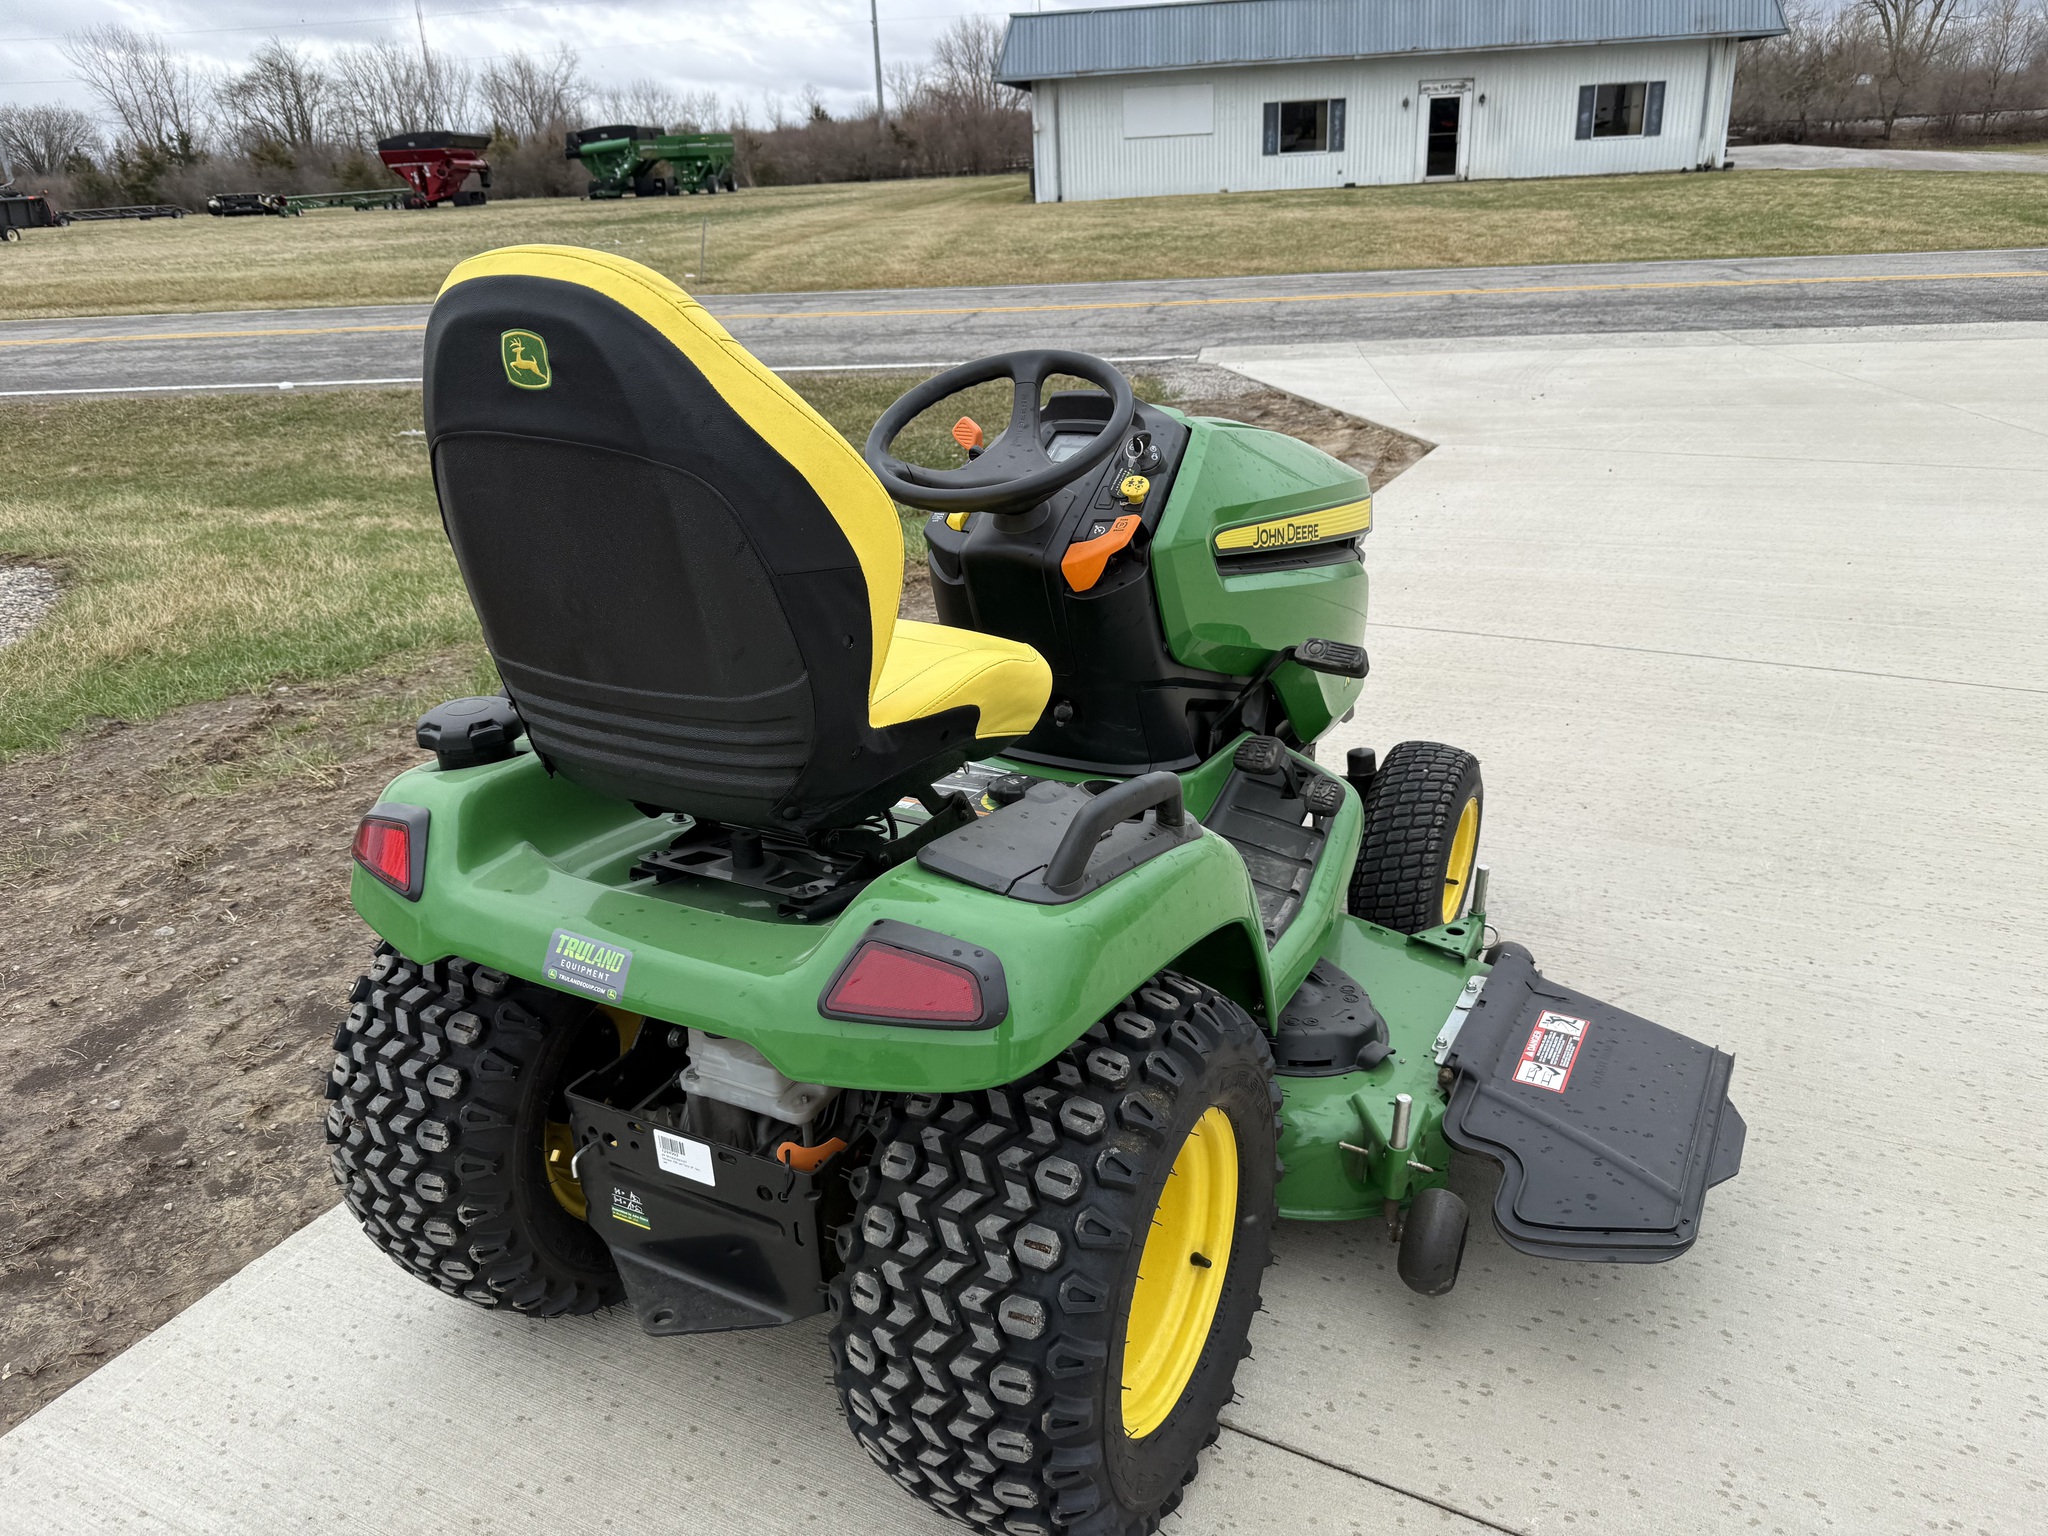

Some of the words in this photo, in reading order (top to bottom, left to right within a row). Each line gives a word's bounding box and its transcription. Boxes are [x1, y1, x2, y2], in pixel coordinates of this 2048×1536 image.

[1253, 526, 1285, 547] JOHN
[1287, 523, 1319, 542] DEERE
[556, 934, 625, 973] TRULAND
[560, 959, 610, 982] EQUIPMENT
[558, 974, 606, 995] TRULANDEQUIP.COM
[1527, 1030, 1542, 1051] DANGER
